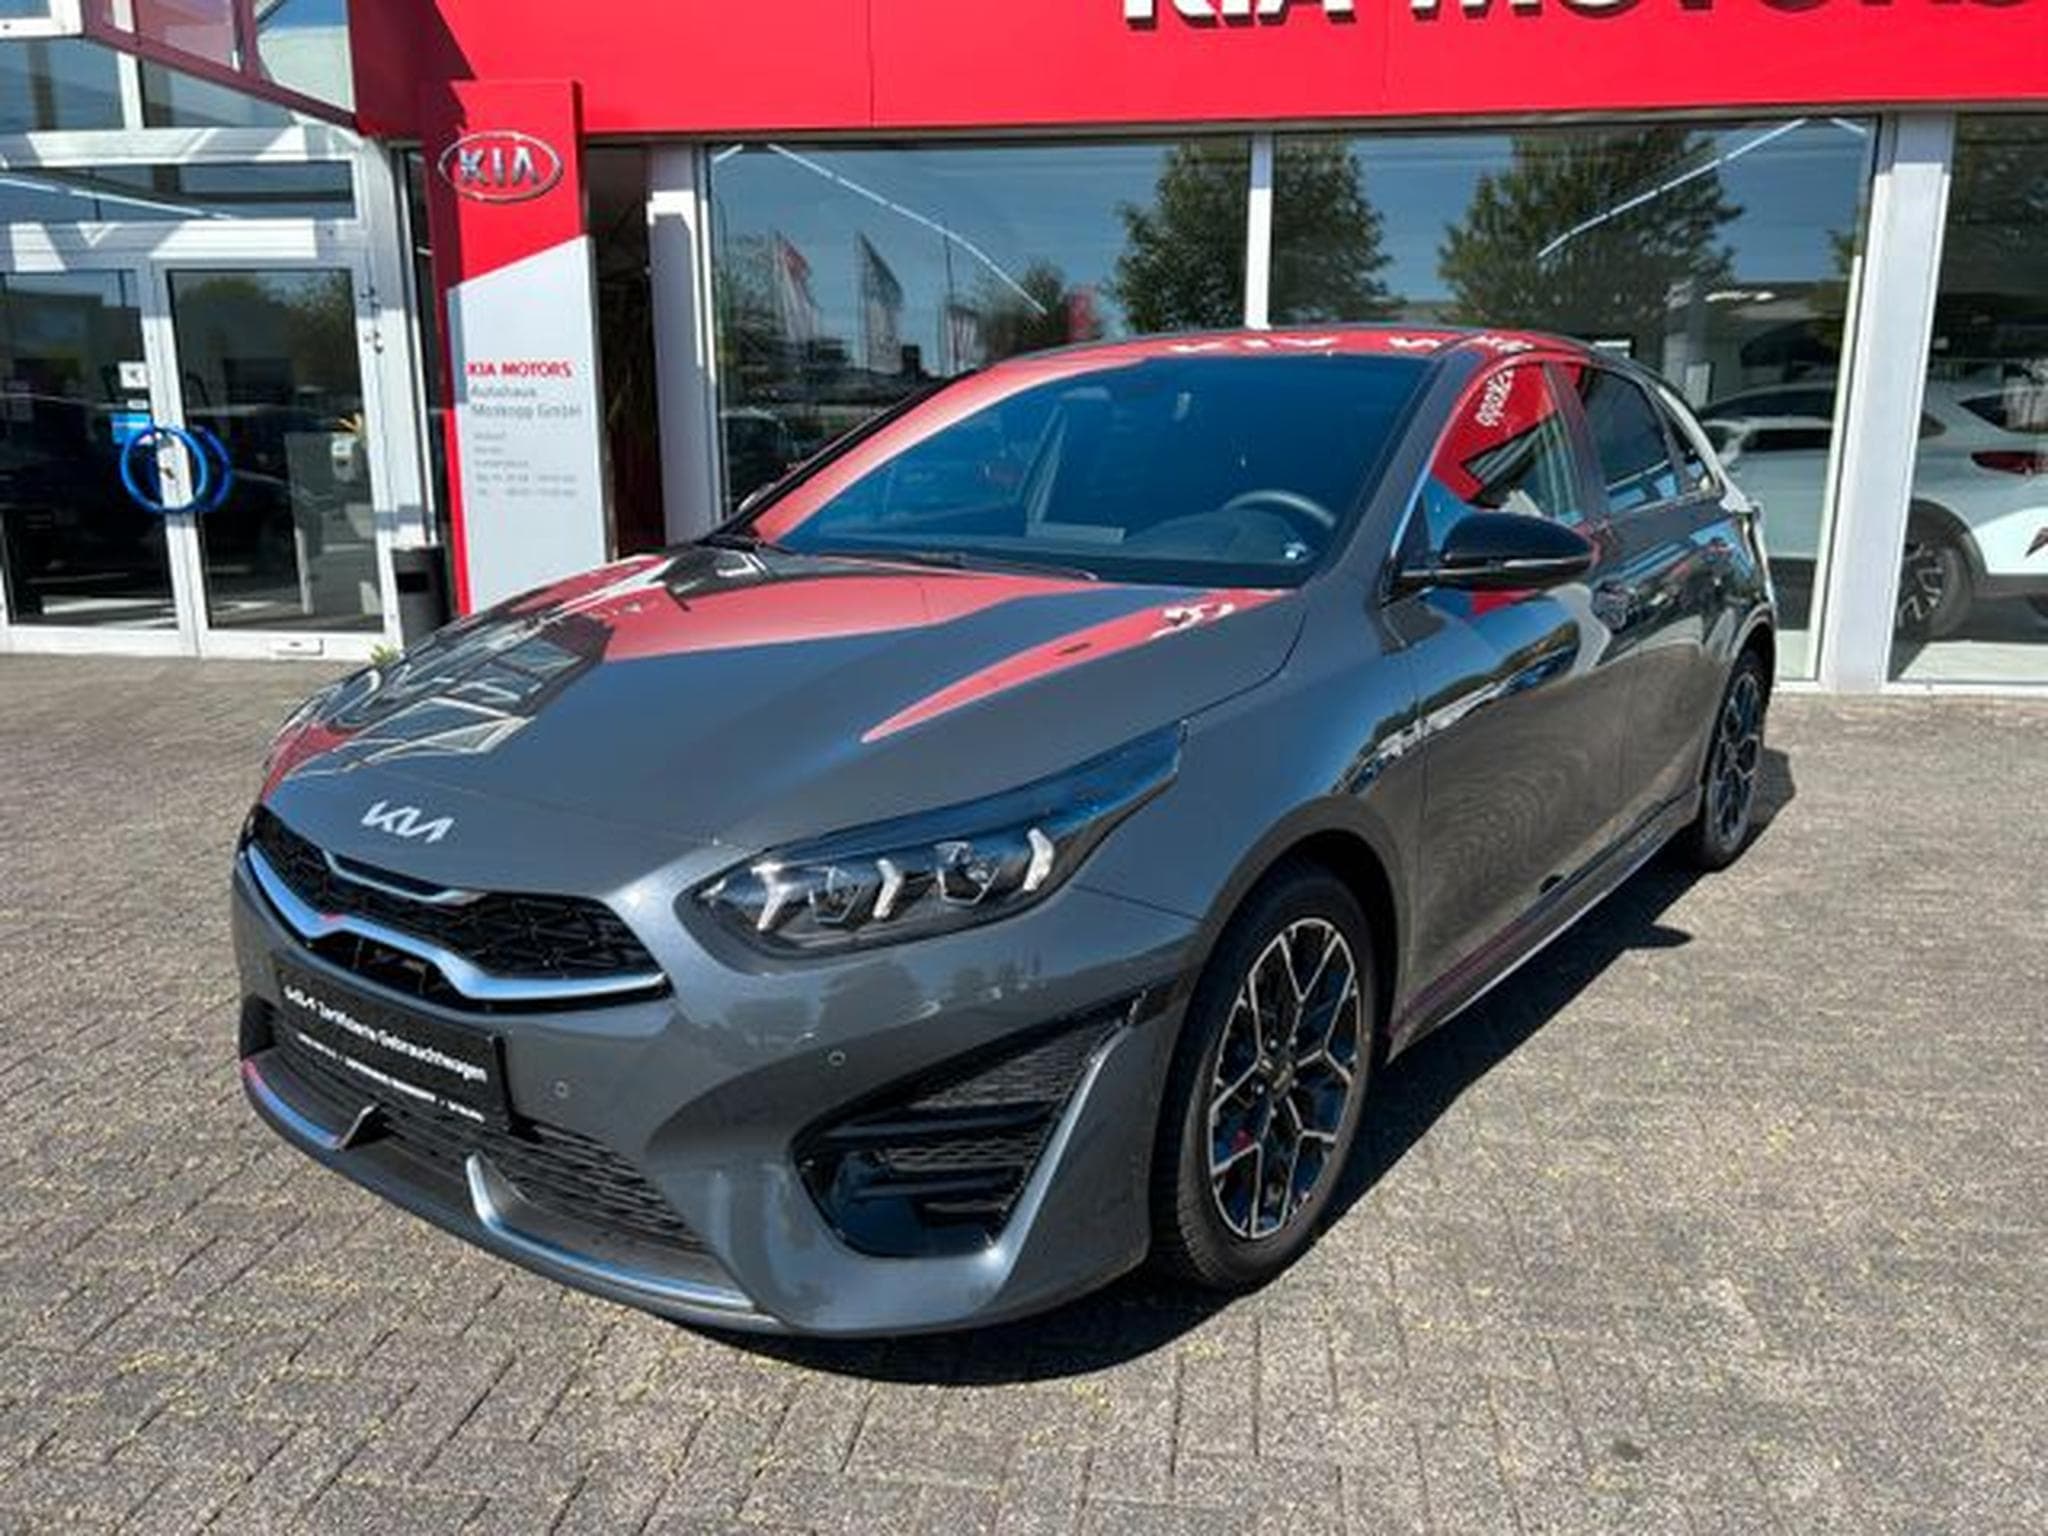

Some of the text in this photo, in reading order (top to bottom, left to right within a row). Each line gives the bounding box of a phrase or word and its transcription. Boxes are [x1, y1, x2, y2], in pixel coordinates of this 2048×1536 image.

[459, 146, 540, 187] KIA
[466, 361, 573, 378] KIA MOTORS
[361, 800, 454, 843] KIA
